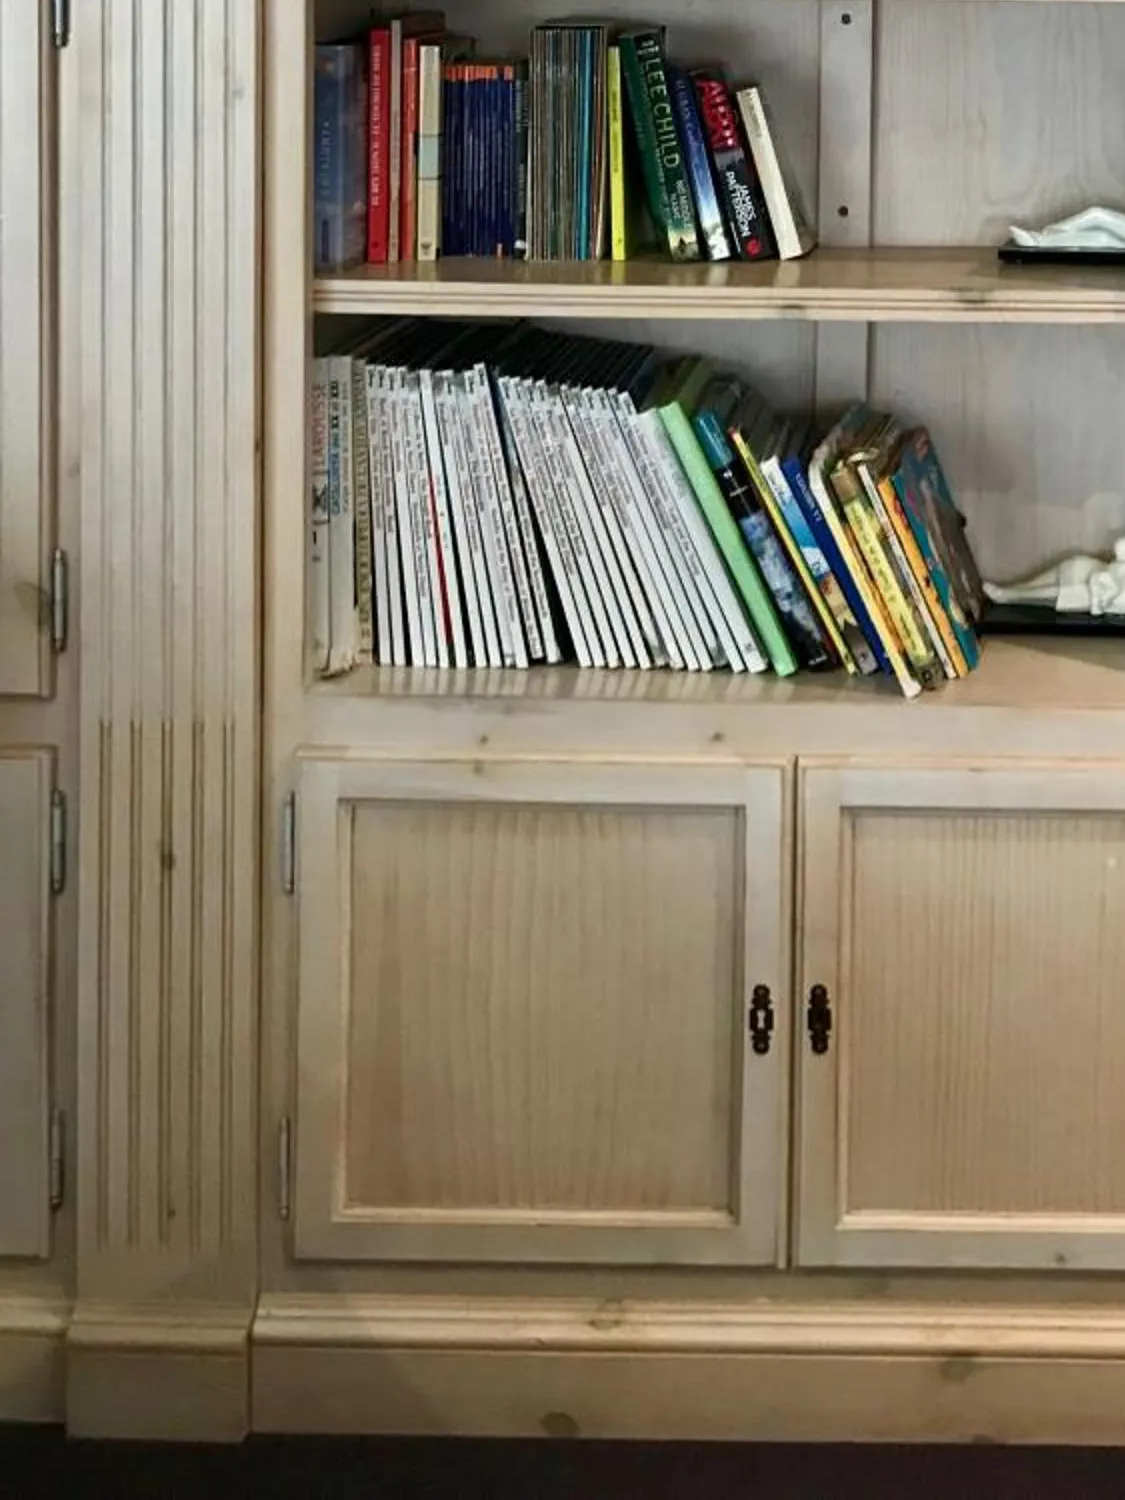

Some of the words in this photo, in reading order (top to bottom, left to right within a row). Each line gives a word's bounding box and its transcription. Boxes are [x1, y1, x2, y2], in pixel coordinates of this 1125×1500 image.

[645, 58, 667, 99] LEE
[654, 103, 680, 169] CHILD
[726, 171, 751, 237] PATTERSON
